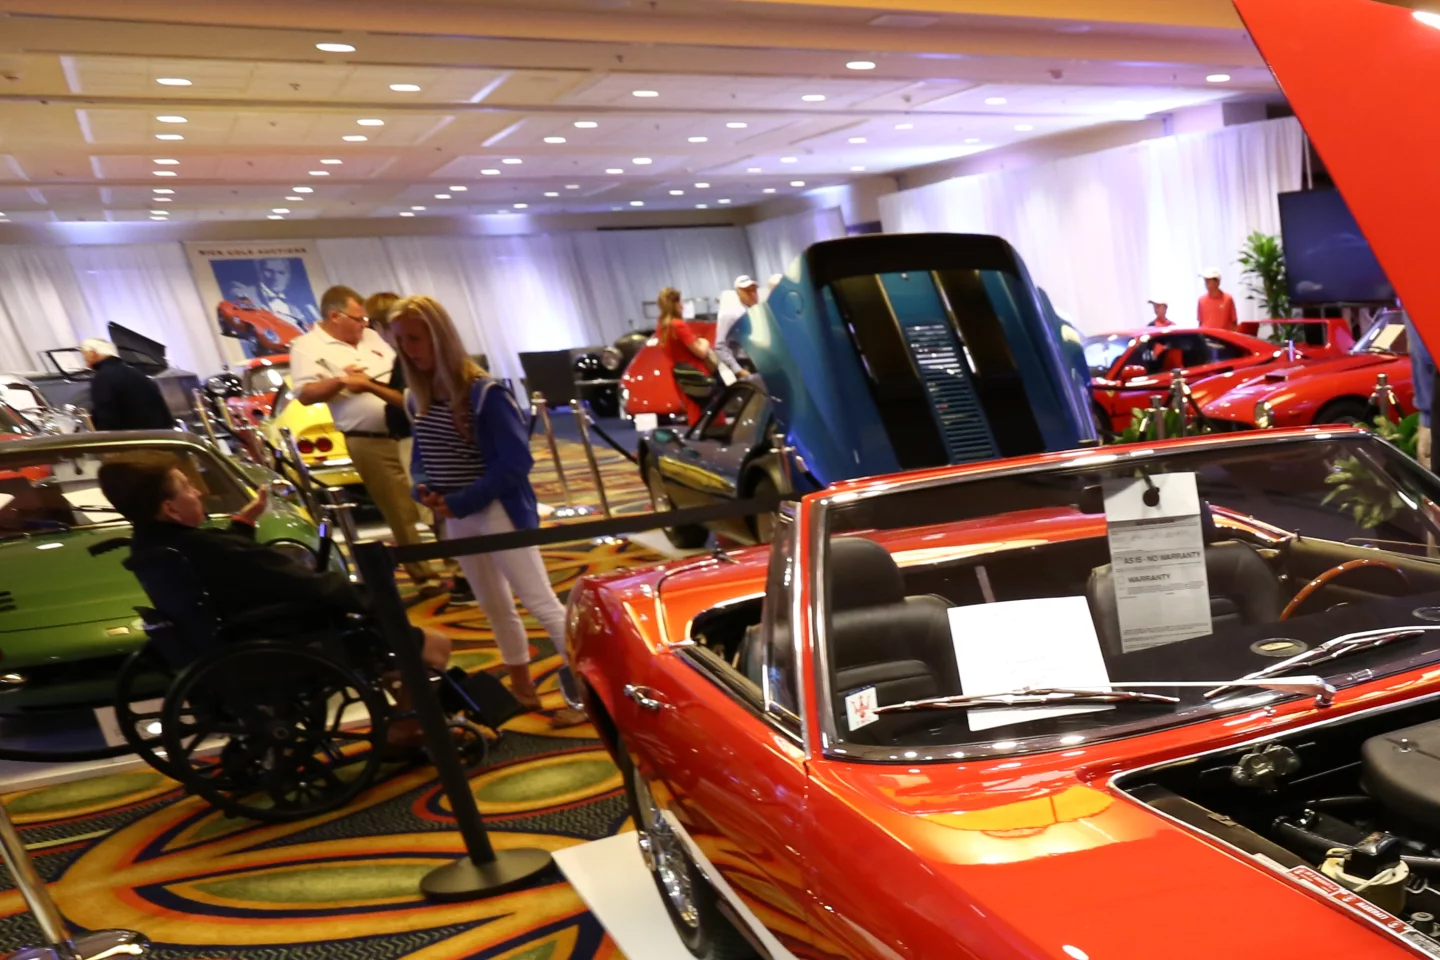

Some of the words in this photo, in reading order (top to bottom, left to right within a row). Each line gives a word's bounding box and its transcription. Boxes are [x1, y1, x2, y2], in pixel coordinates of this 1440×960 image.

[1135, 556, 1142, 564] IS
[1160, 551, 1200, 561] WARRANTY
[1128, 573, 1171, 582] WARRANTY
